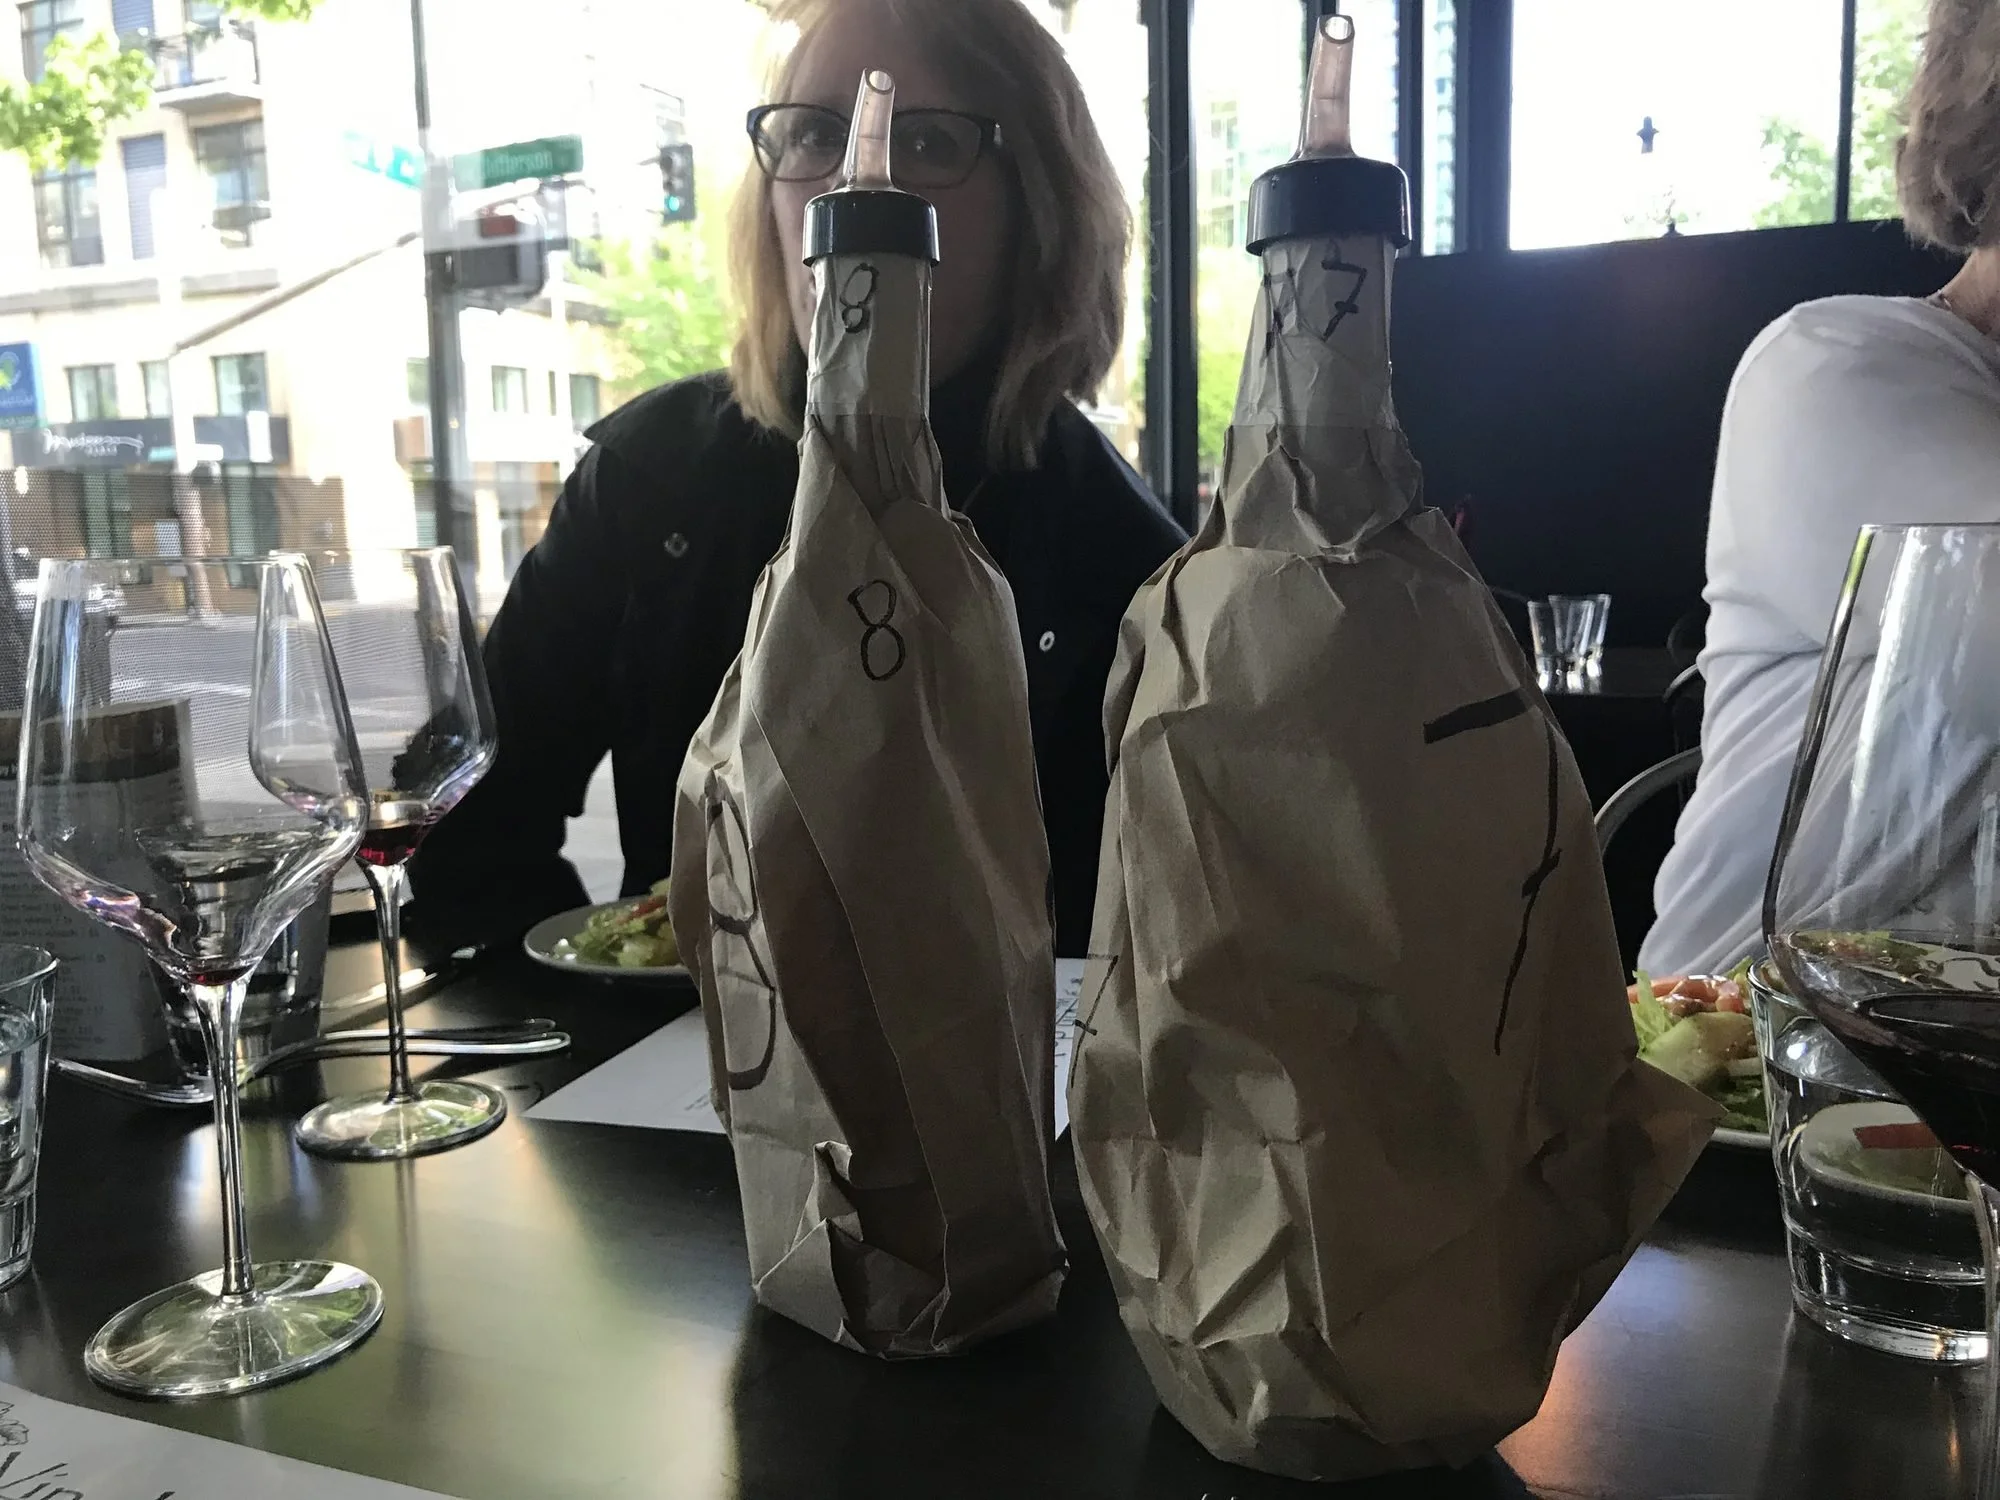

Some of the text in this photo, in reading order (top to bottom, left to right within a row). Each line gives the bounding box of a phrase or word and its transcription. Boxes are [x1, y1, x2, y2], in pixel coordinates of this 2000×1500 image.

[839, 263, 880, 334] 8
[1320, 259, 1368, 342] 7
[847, 579, 906, 682] 8
[1423, 687, 1562, 1056] 7
